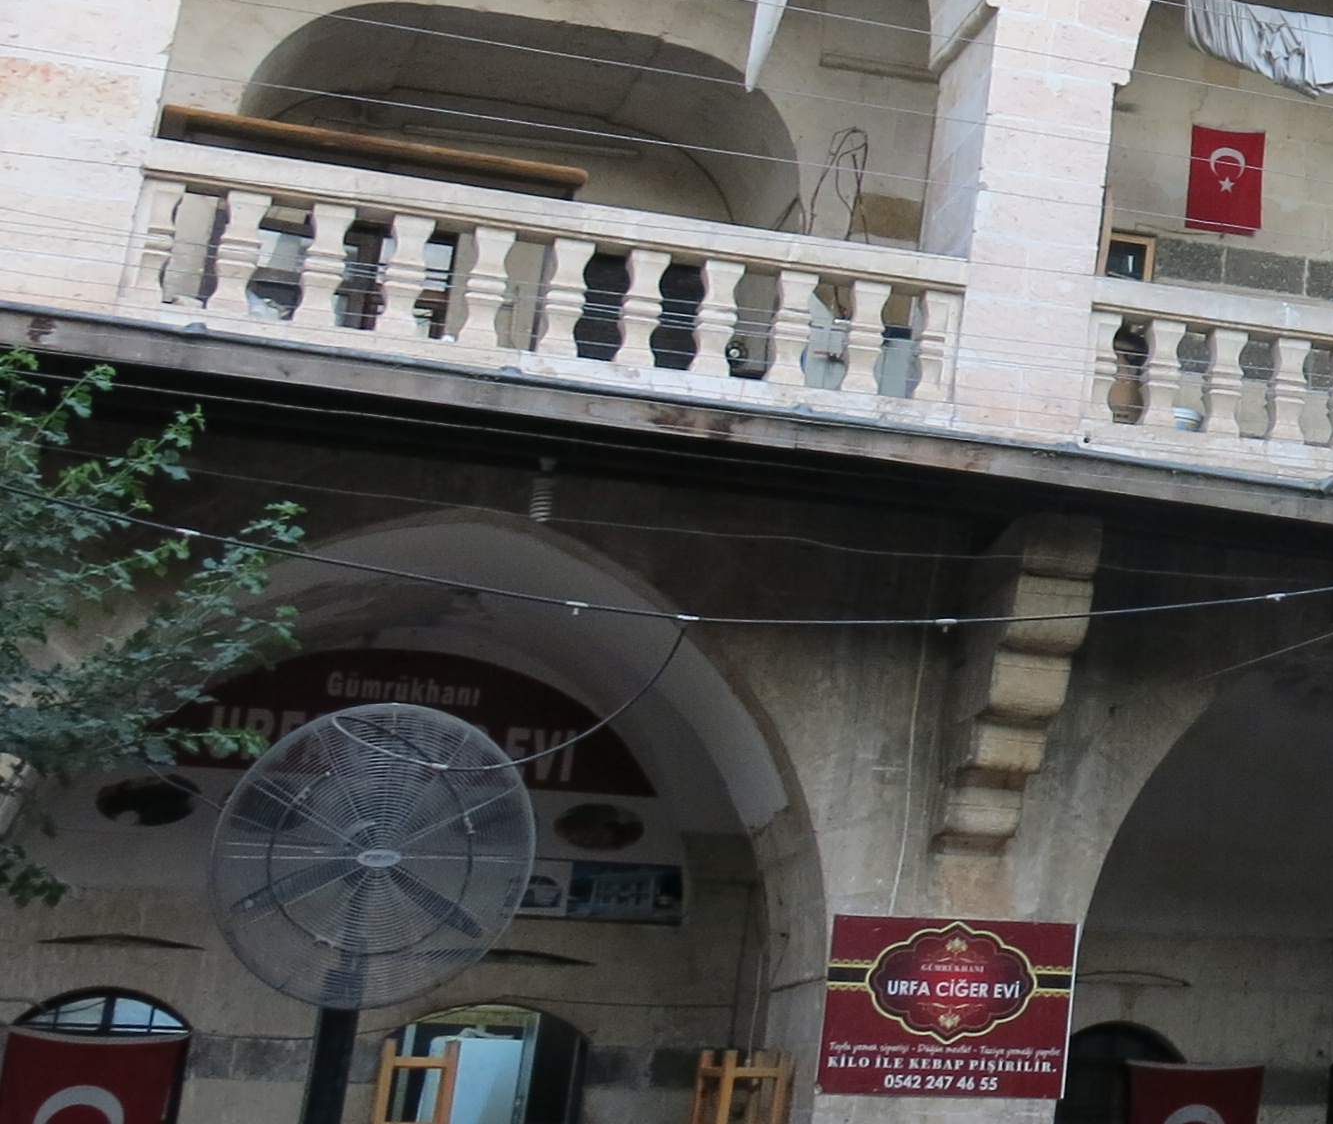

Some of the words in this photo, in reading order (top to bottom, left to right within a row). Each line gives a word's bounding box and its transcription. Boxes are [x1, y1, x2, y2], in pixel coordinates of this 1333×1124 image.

[327, 671, 481, 707] Gümrükhanı
[886, 979, 931, 996] URFA
[935, 978, 989, 999] CİĞER
[992, 980, 1020, 999] EVİ
[827, 1054, 871, 1068] KİLO
[875, 1054, 904, 1069] İLE
[909, 1057, 964, 1071] KEBAP
[969, 1056, 1057, 1073] PİŞİRİLİR.
[883, 1074, 922, 1089] 0542
[924, 1075, 954, 1090] 247
[956, 1076, 976, 1090] 46
[979, 1076, 998, 1091] 55
